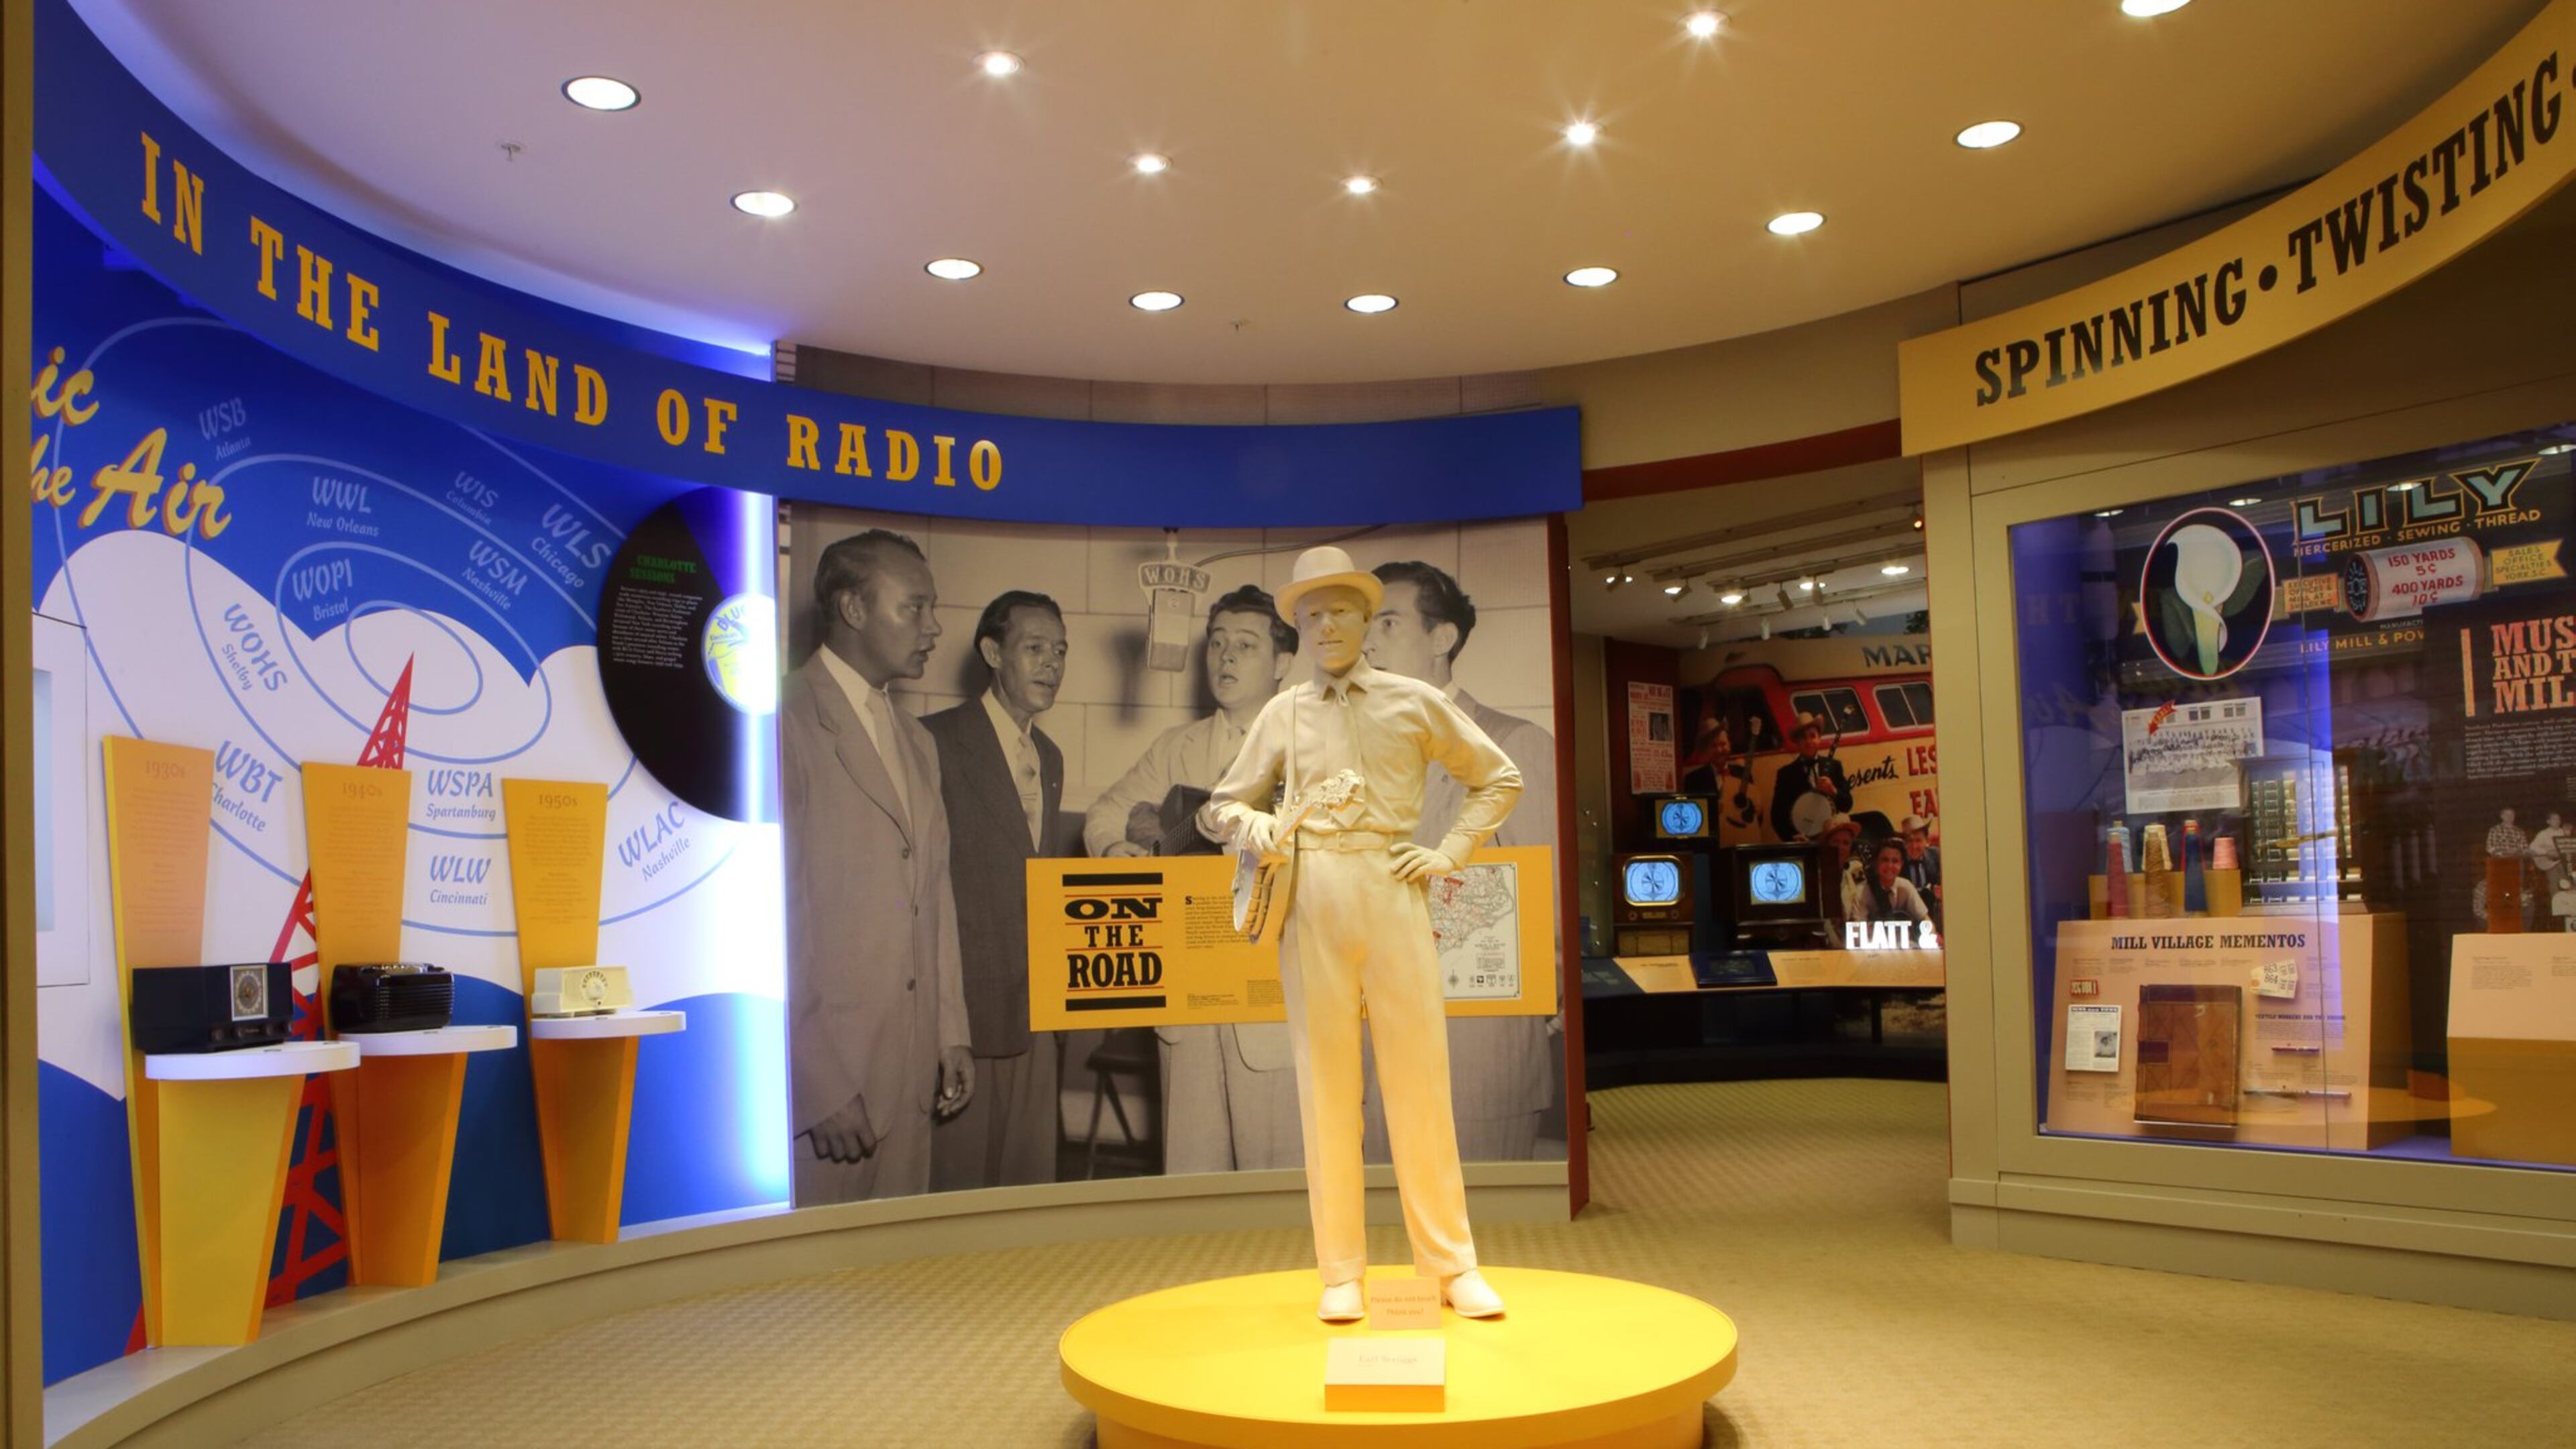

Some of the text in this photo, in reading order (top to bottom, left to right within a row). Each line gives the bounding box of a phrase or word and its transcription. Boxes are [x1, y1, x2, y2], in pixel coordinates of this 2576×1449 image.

[1976, 51, 2561, 407] SPINNING TWISTING
[142, 131, 1002, 490] IN THE LAND OF RADIO
[199, 397, 246, 441] WSB
[215, 437, 251, 462] Atlanta
[77, 427, 232, 540] Air
[312, 477, 372, 514] WWL
[454, 470, 499, 508] WIS
[2290, 458, 2542, 545] LILY
[307, 512, 380, 537] New Orleans
[446, 490, 492, 527] Columbia
[541, 502, 612, 569] WLS
[2294, 510, 2541, 557] MERCERIZED SEWING THREAD
[468, 539, 529, 596] WSM
[531, 536, 585, 590] Chicago
[2387, 548, 2456, 568] 150 YARDS
[292, 559, 354, 601] WOPI
[462, 570, 513, 612] Nashville
[2392, 576, 2463, 595] 400 YARDS
[313, 598, 350, 622] Bristol
[223, 602, 288, 693] WOHS
[2335, 635, 2373, 649] MILL
[2378, 633, 2387, 645] &
[2491, 615, 2575, 657] MUS
[221, 643, 253, 691] Shelby
[2493, 652, 2553, 681] AND
[2493, 676, 2575, 714] MIL
[215, 740, 283, 803] WBT
[427, 769, 494, 798] WSPA
[342, 782, 383, 799] 1940s
[539, 794, 578, 809] 1950s
[426, 804, 496, 822] Spartanburg
[618, 801, 685, 867] WLAC
[429, 855, 491, 884] WLW
[641, 837, 690, 881] Nashville
[430, 889, 488, 906] Cincinnati
[1065, 897, 1163, 920] ON
[1084, 924, 1143, 948] THE
[2112, 933, 2306, 950] MILL VILLAGE MEMENTOS
[1067, 952, 1163, 988] ROAD
